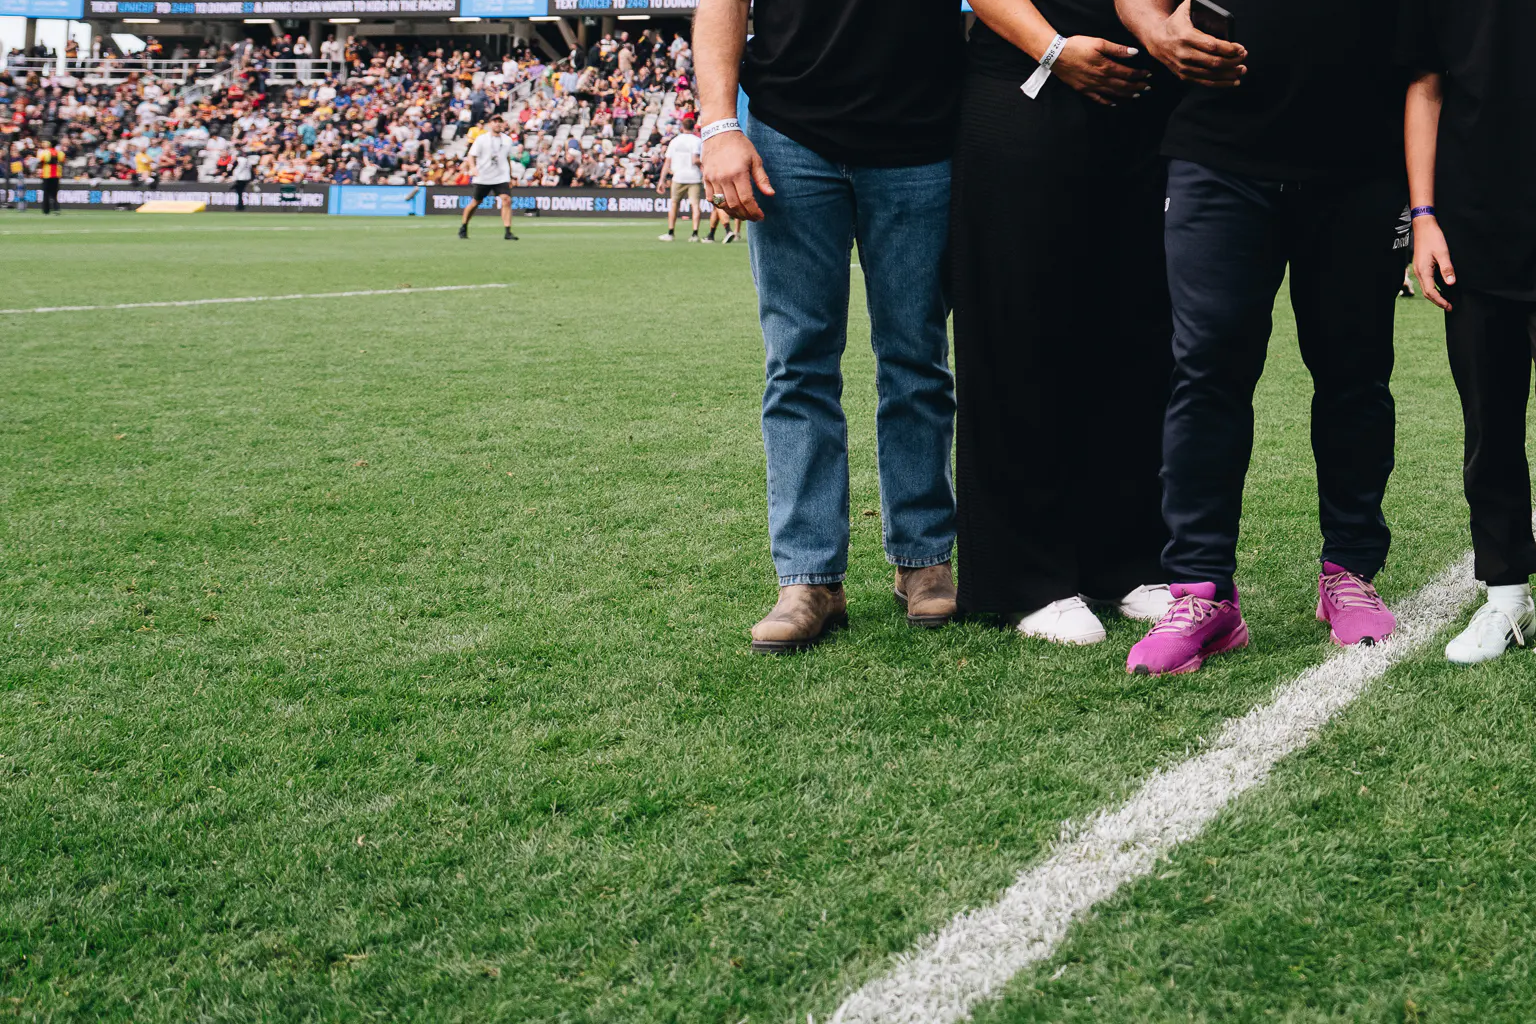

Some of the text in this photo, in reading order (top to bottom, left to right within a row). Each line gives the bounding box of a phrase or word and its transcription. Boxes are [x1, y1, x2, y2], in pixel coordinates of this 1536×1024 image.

[433, 195, 459, 208] TEXT
[511, 197, 536, 209] 2449
[536, 197, 551, 210] TO
[551, 197, 594, 210] DONATE
[607, 197, 618, 211] &
[618, 198, 653, 211] BRING
